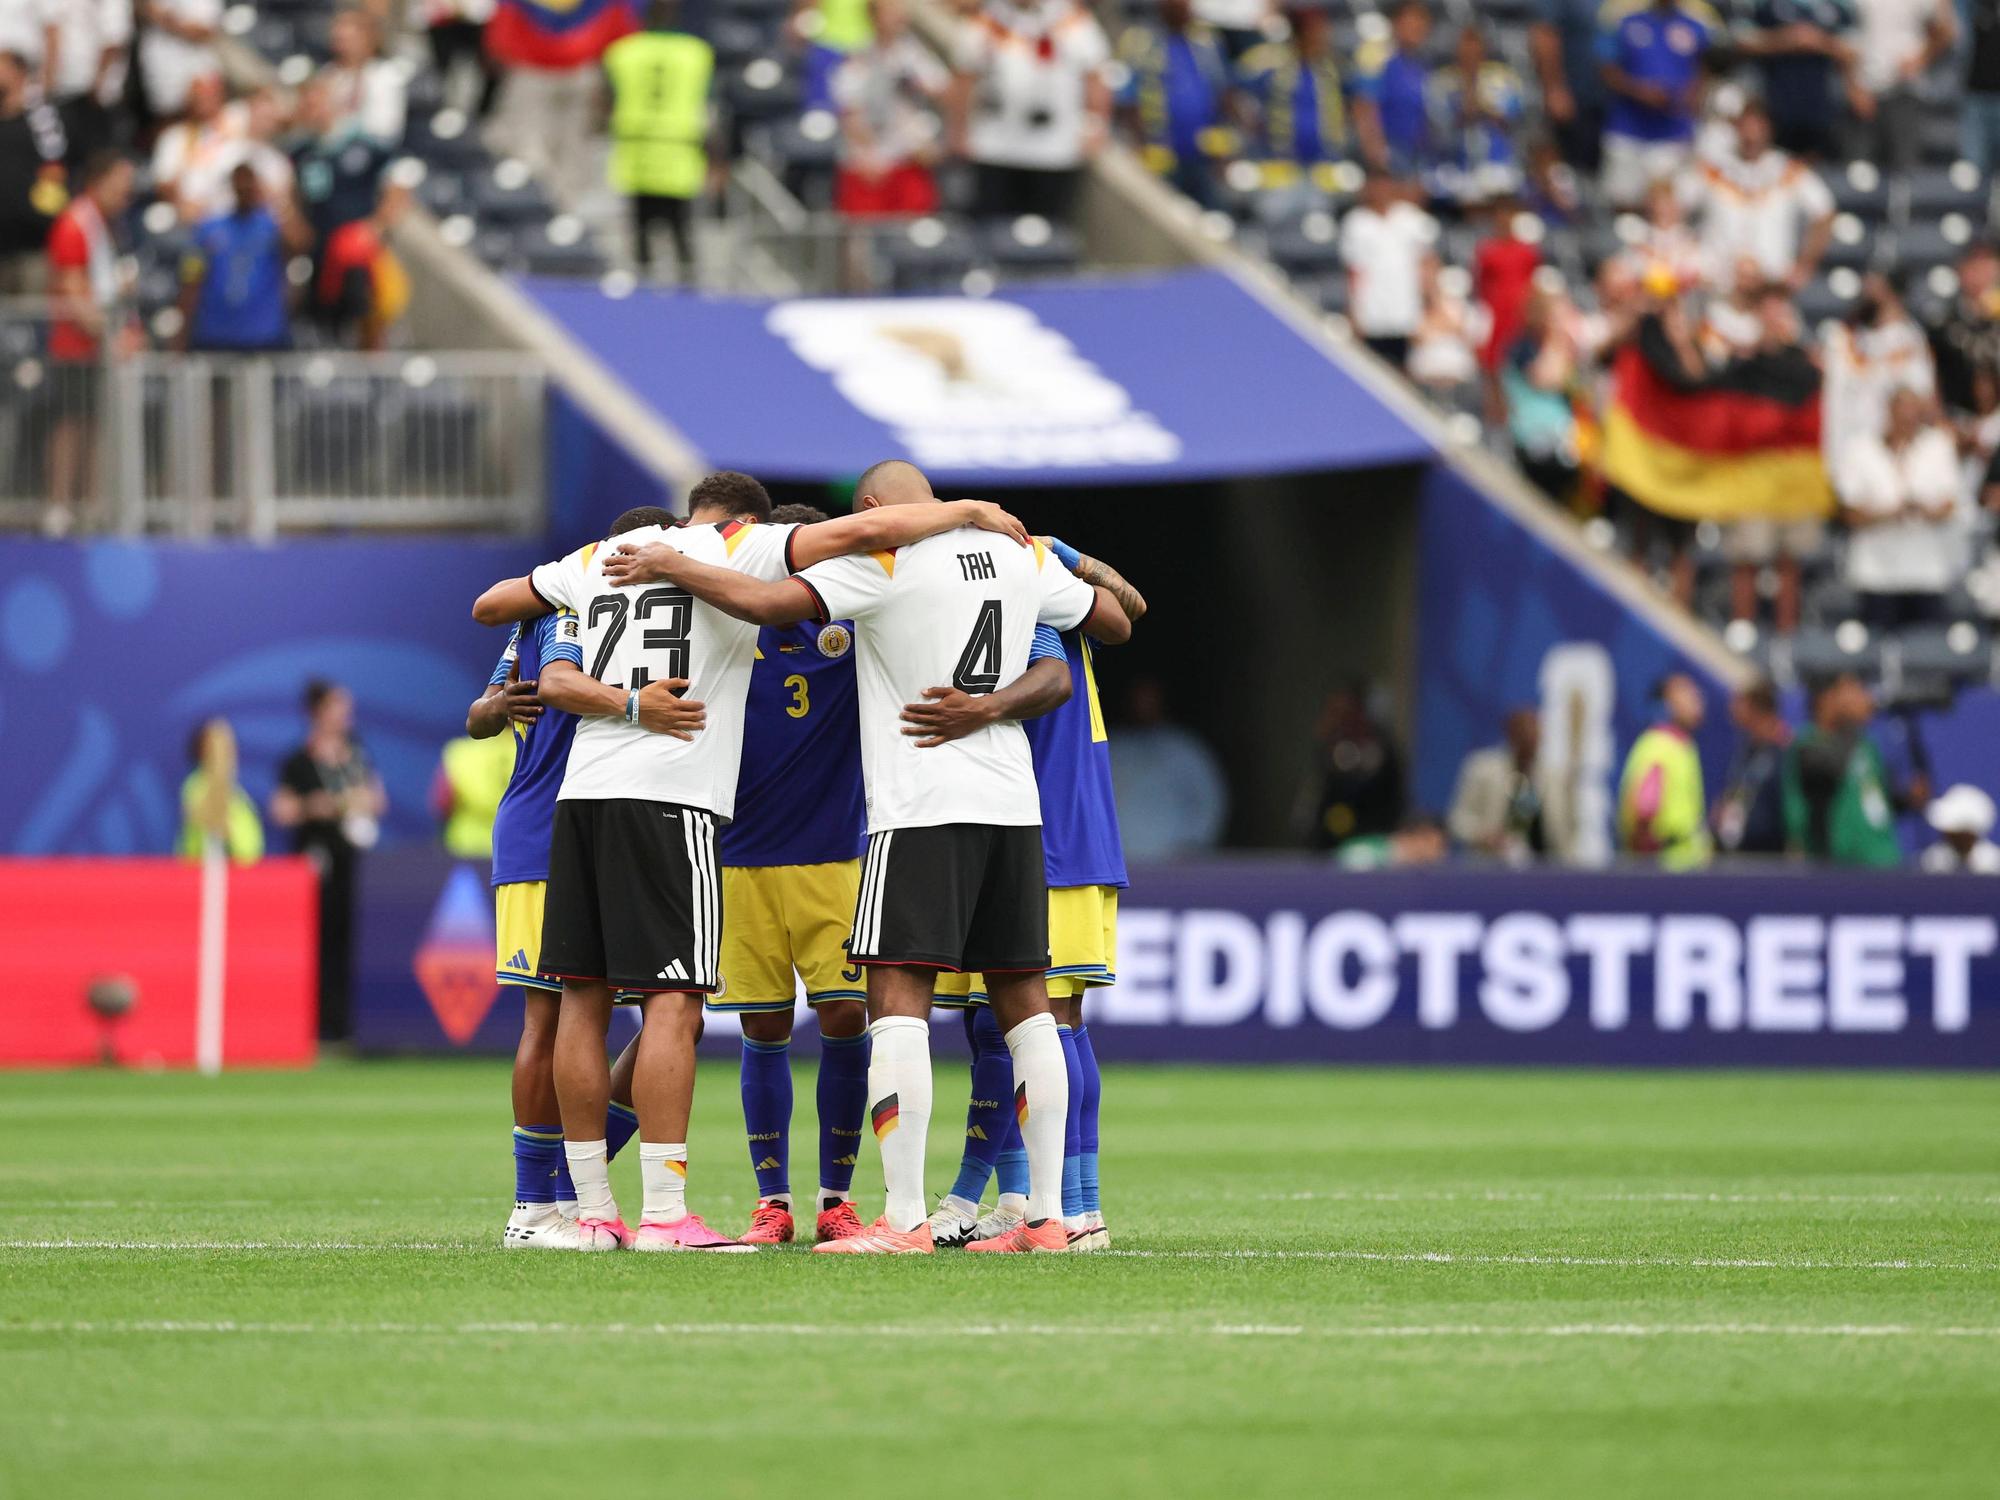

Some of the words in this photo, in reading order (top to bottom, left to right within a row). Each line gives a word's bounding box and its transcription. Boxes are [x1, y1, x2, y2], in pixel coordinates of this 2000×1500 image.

[957, 551, 997, 581] TAH
[588, 587, 693, 698] 23
[953, 600, 1002, 694] 4
[784, 674, 810, 718] 3
[1083, 906, 1997, 1034] EDICTSTREET
